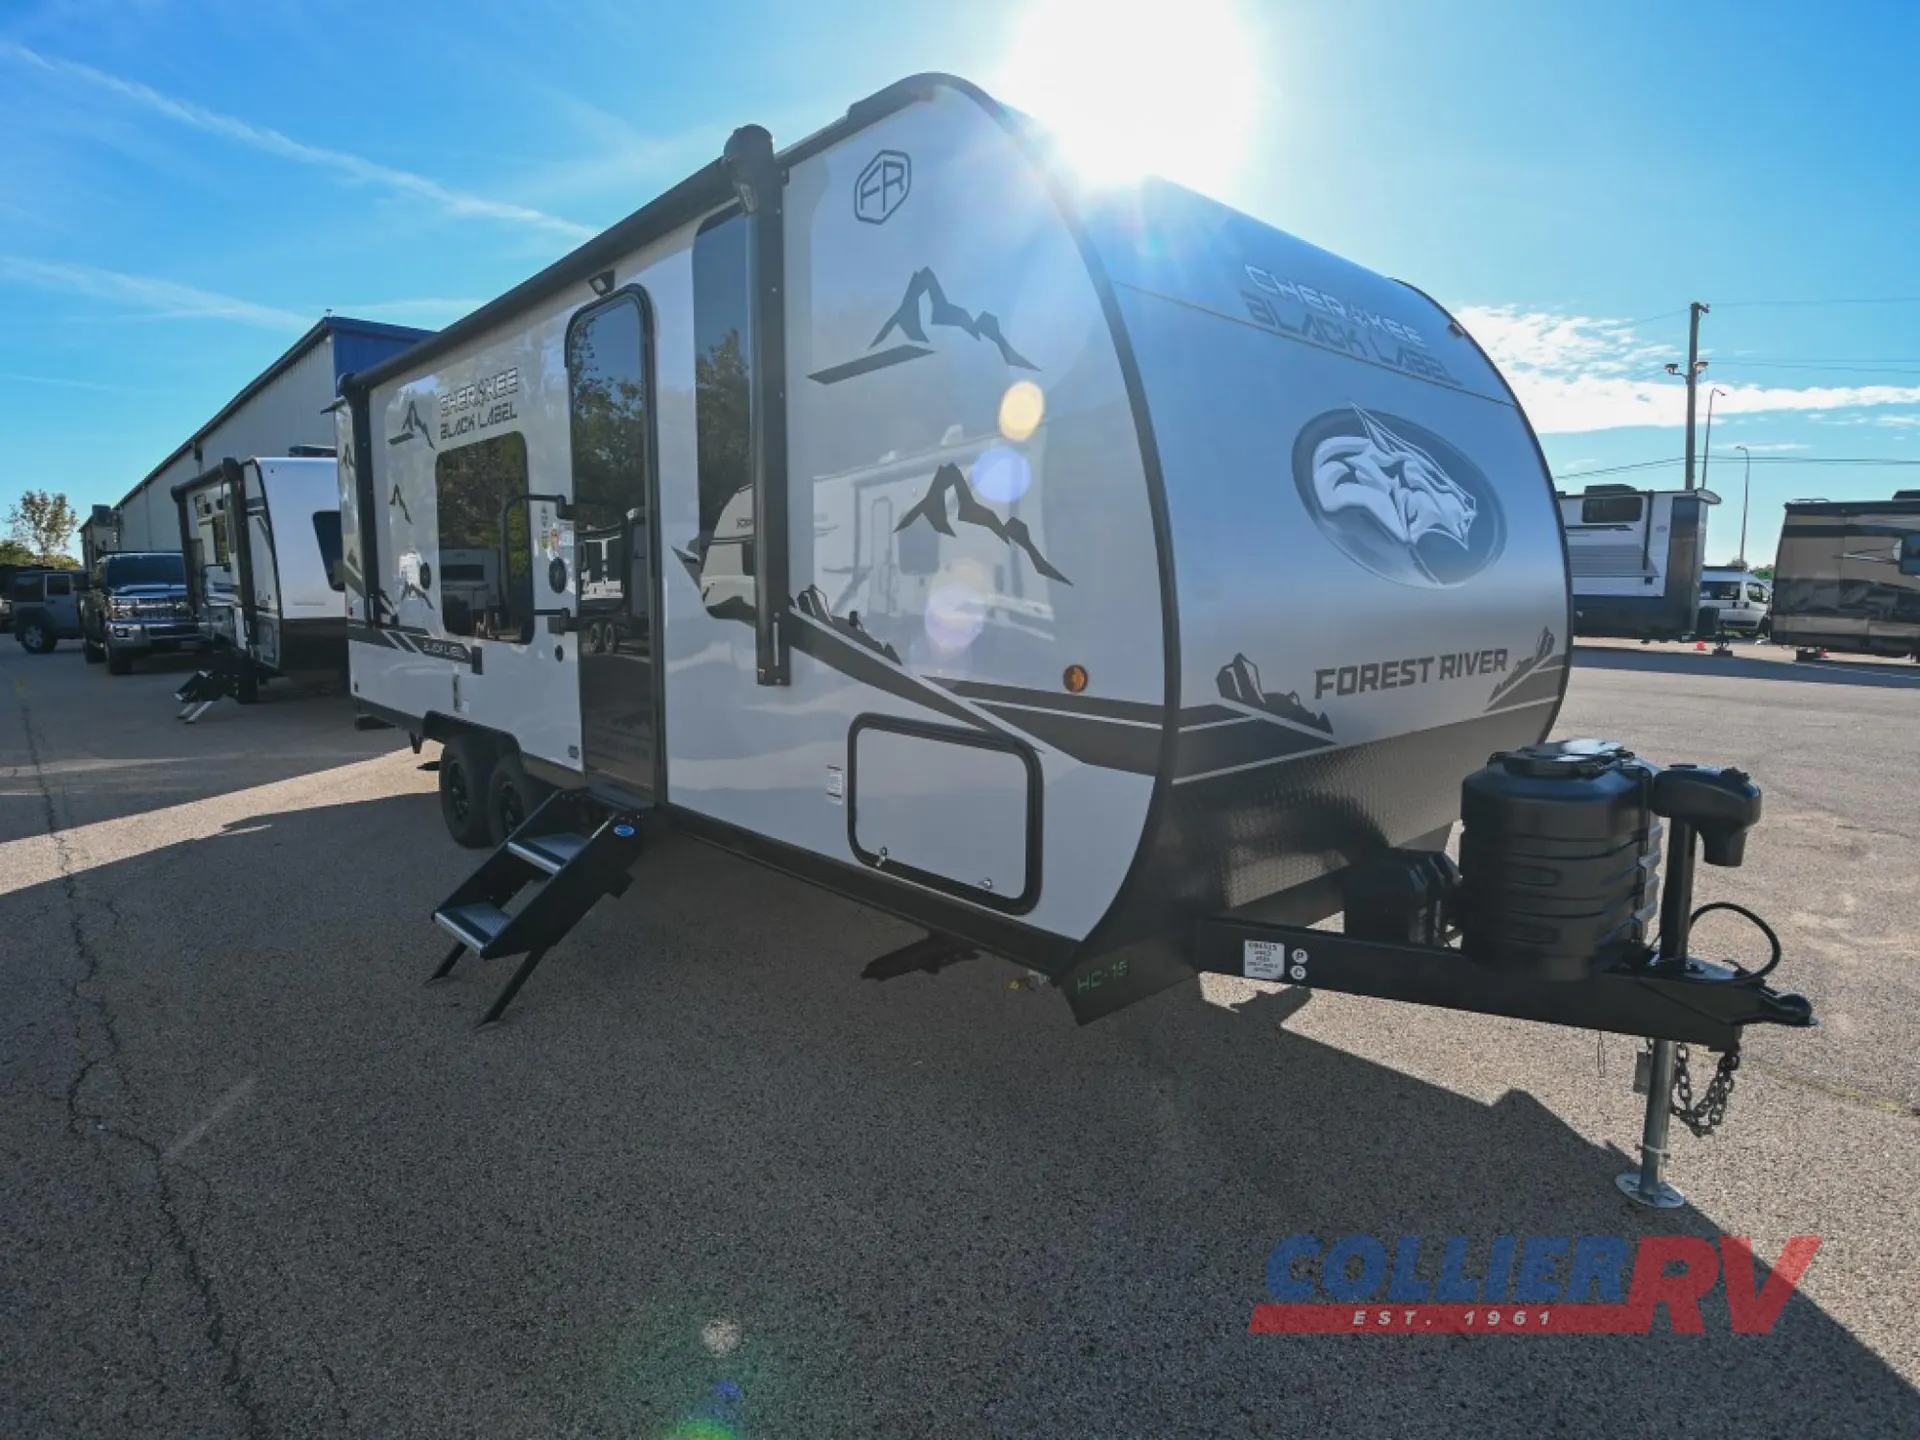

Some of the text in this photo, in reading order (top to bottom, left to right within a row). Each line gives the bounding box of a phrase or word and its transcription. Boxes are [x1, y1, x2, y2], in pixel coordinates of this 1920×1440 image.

[1241, 292, 1464, 386] BLACK LABEL
[440, 401, 518, 440] BLACK LABEL
[1314, 648, 1508, 700] FOREST RIVER
